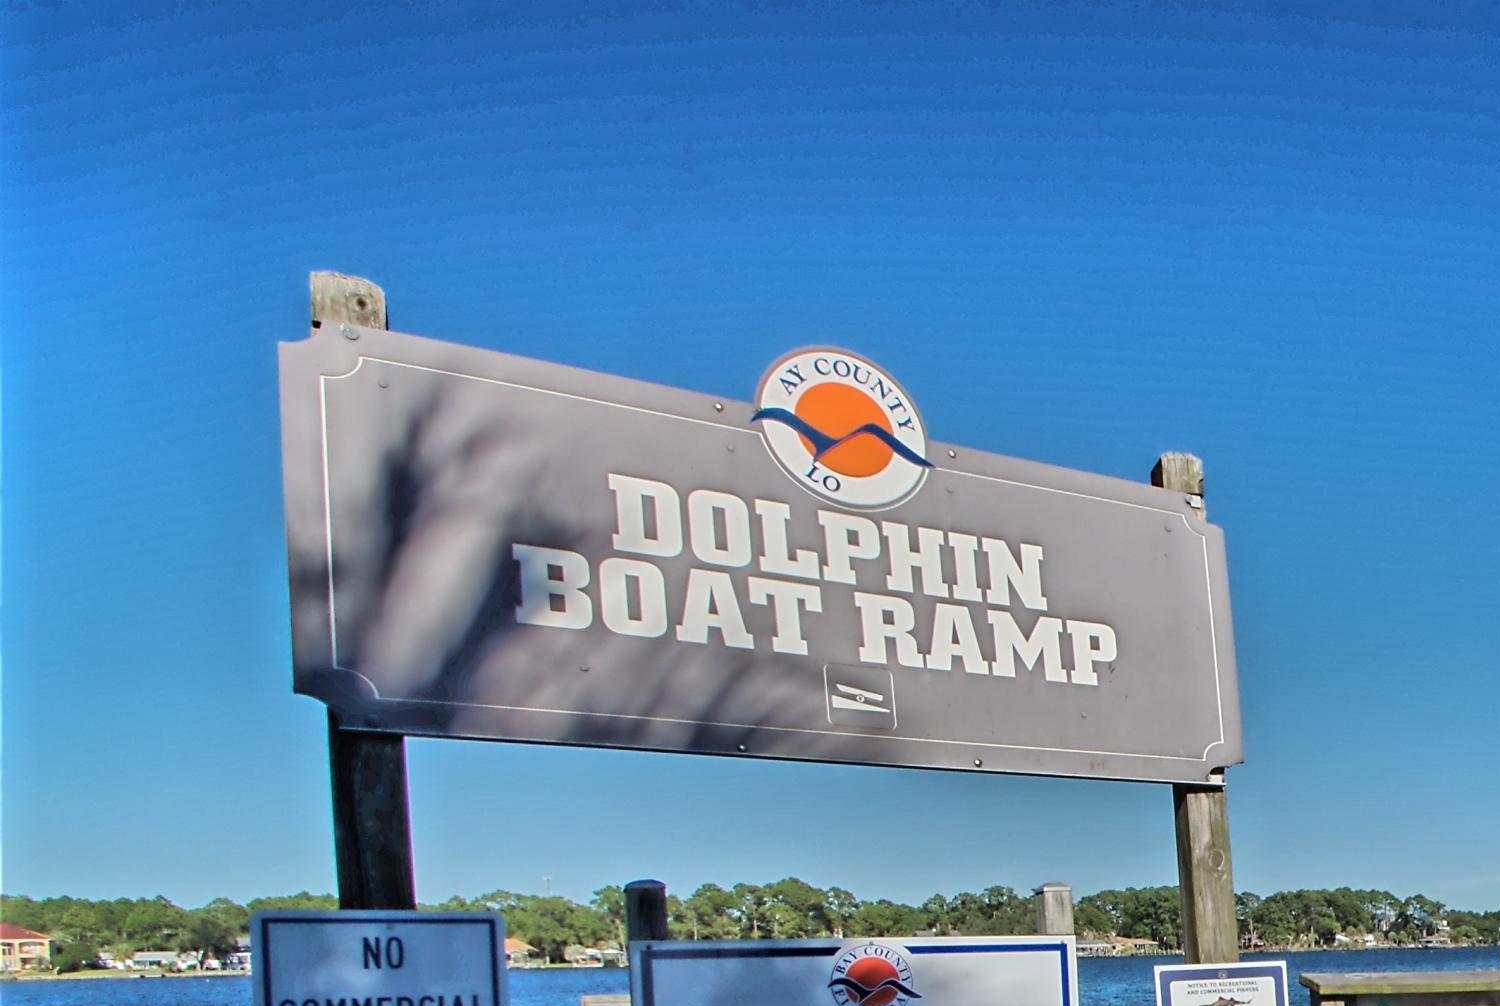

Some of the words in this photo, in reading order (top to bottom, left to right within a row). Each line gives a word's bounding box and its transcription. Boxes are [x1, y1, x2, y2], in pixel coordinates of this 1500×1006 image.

[814, 358, 916, 433] COUNTY
[607, 472, 1048, 612] DOLPHIN
[512, 542, 821, 657] BOAT
[855, 590, 1118, 687] RAMP
[362, 936, 404, 970] NO
[835, 952, 857, 975] BAY
[864, 946, 911, 983] COUNTY
